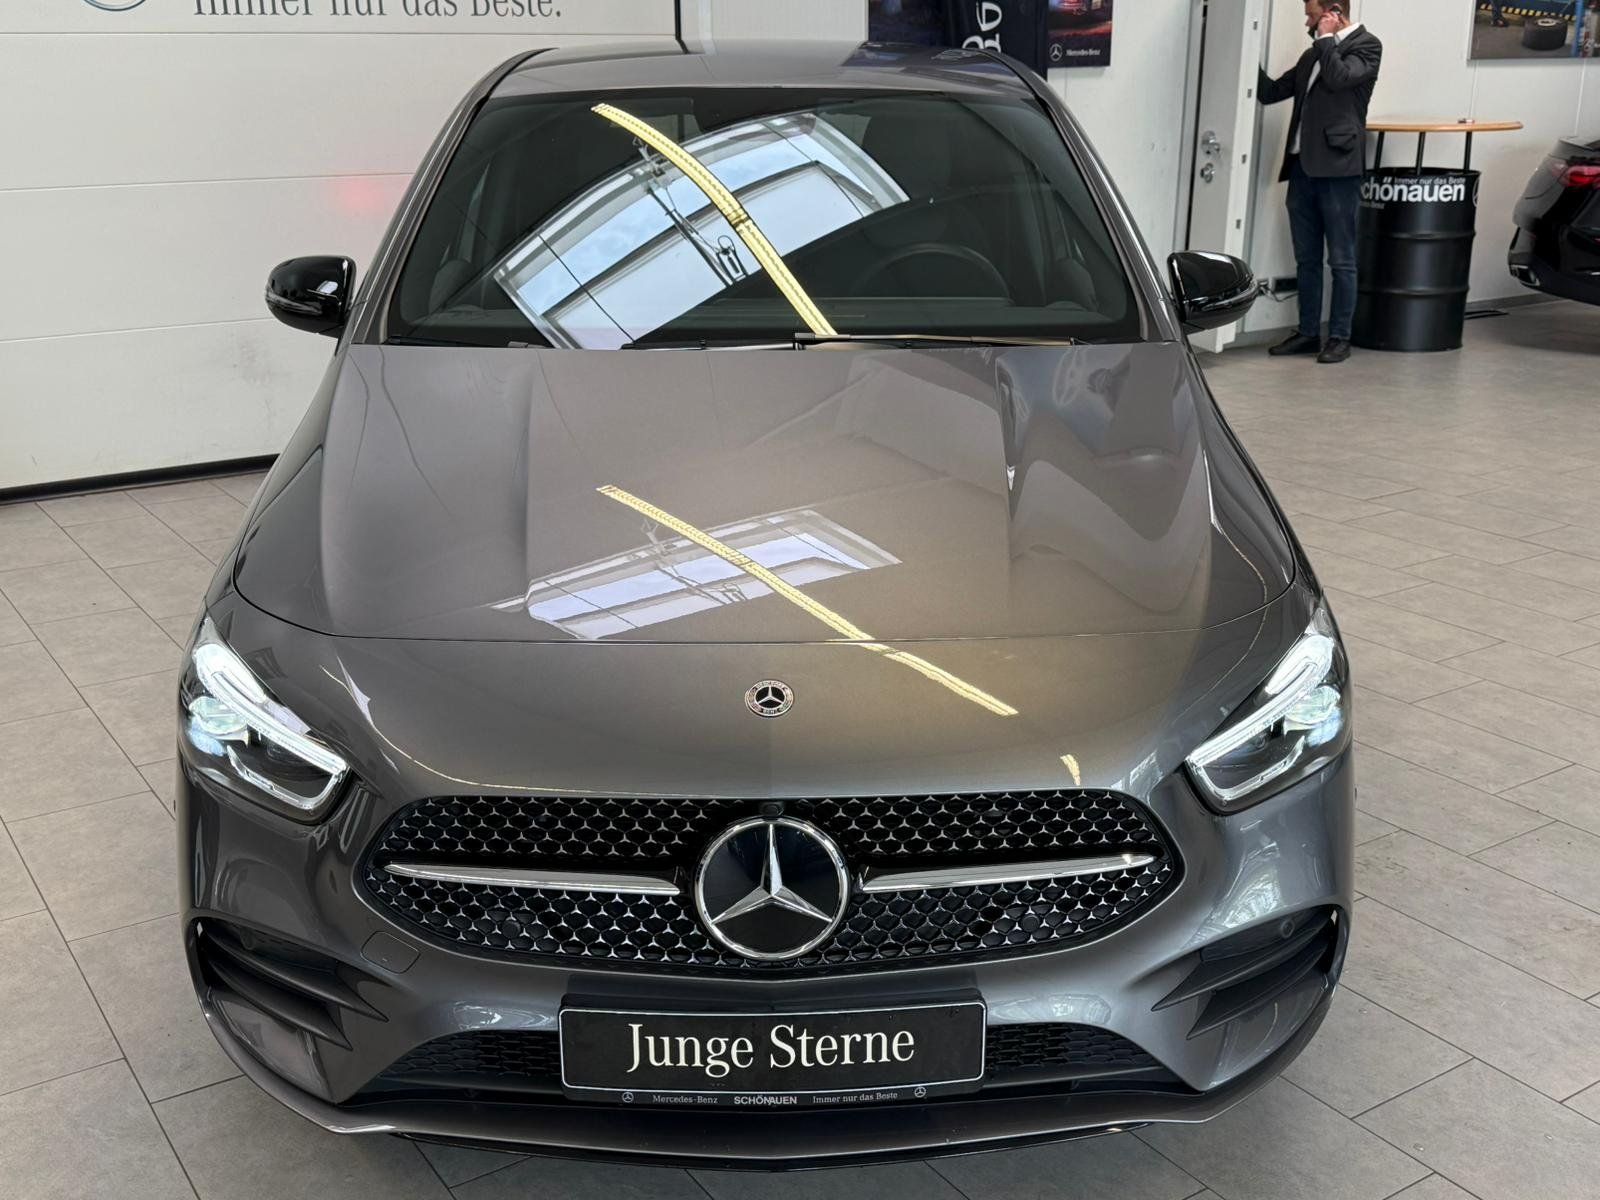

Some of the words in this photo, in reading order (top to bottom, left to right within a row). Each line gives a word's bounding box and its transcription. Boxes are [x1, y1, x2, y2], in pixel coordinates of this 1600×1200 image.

[1360, 177, 1466, 202] chönauen
[626, 1023, 754, 1078] Junge
[770, 1024, 915, 1068] Sterne
[652, 1094, 718, 1104] Mercedes-Benz
[734, 1094, 798, 1105] SCHÖNAUEN
[813, 1095, 840, 1104] Immer
[859, 1093, 874, 1101] das
[876, 1091, 898, 1100] Beste
